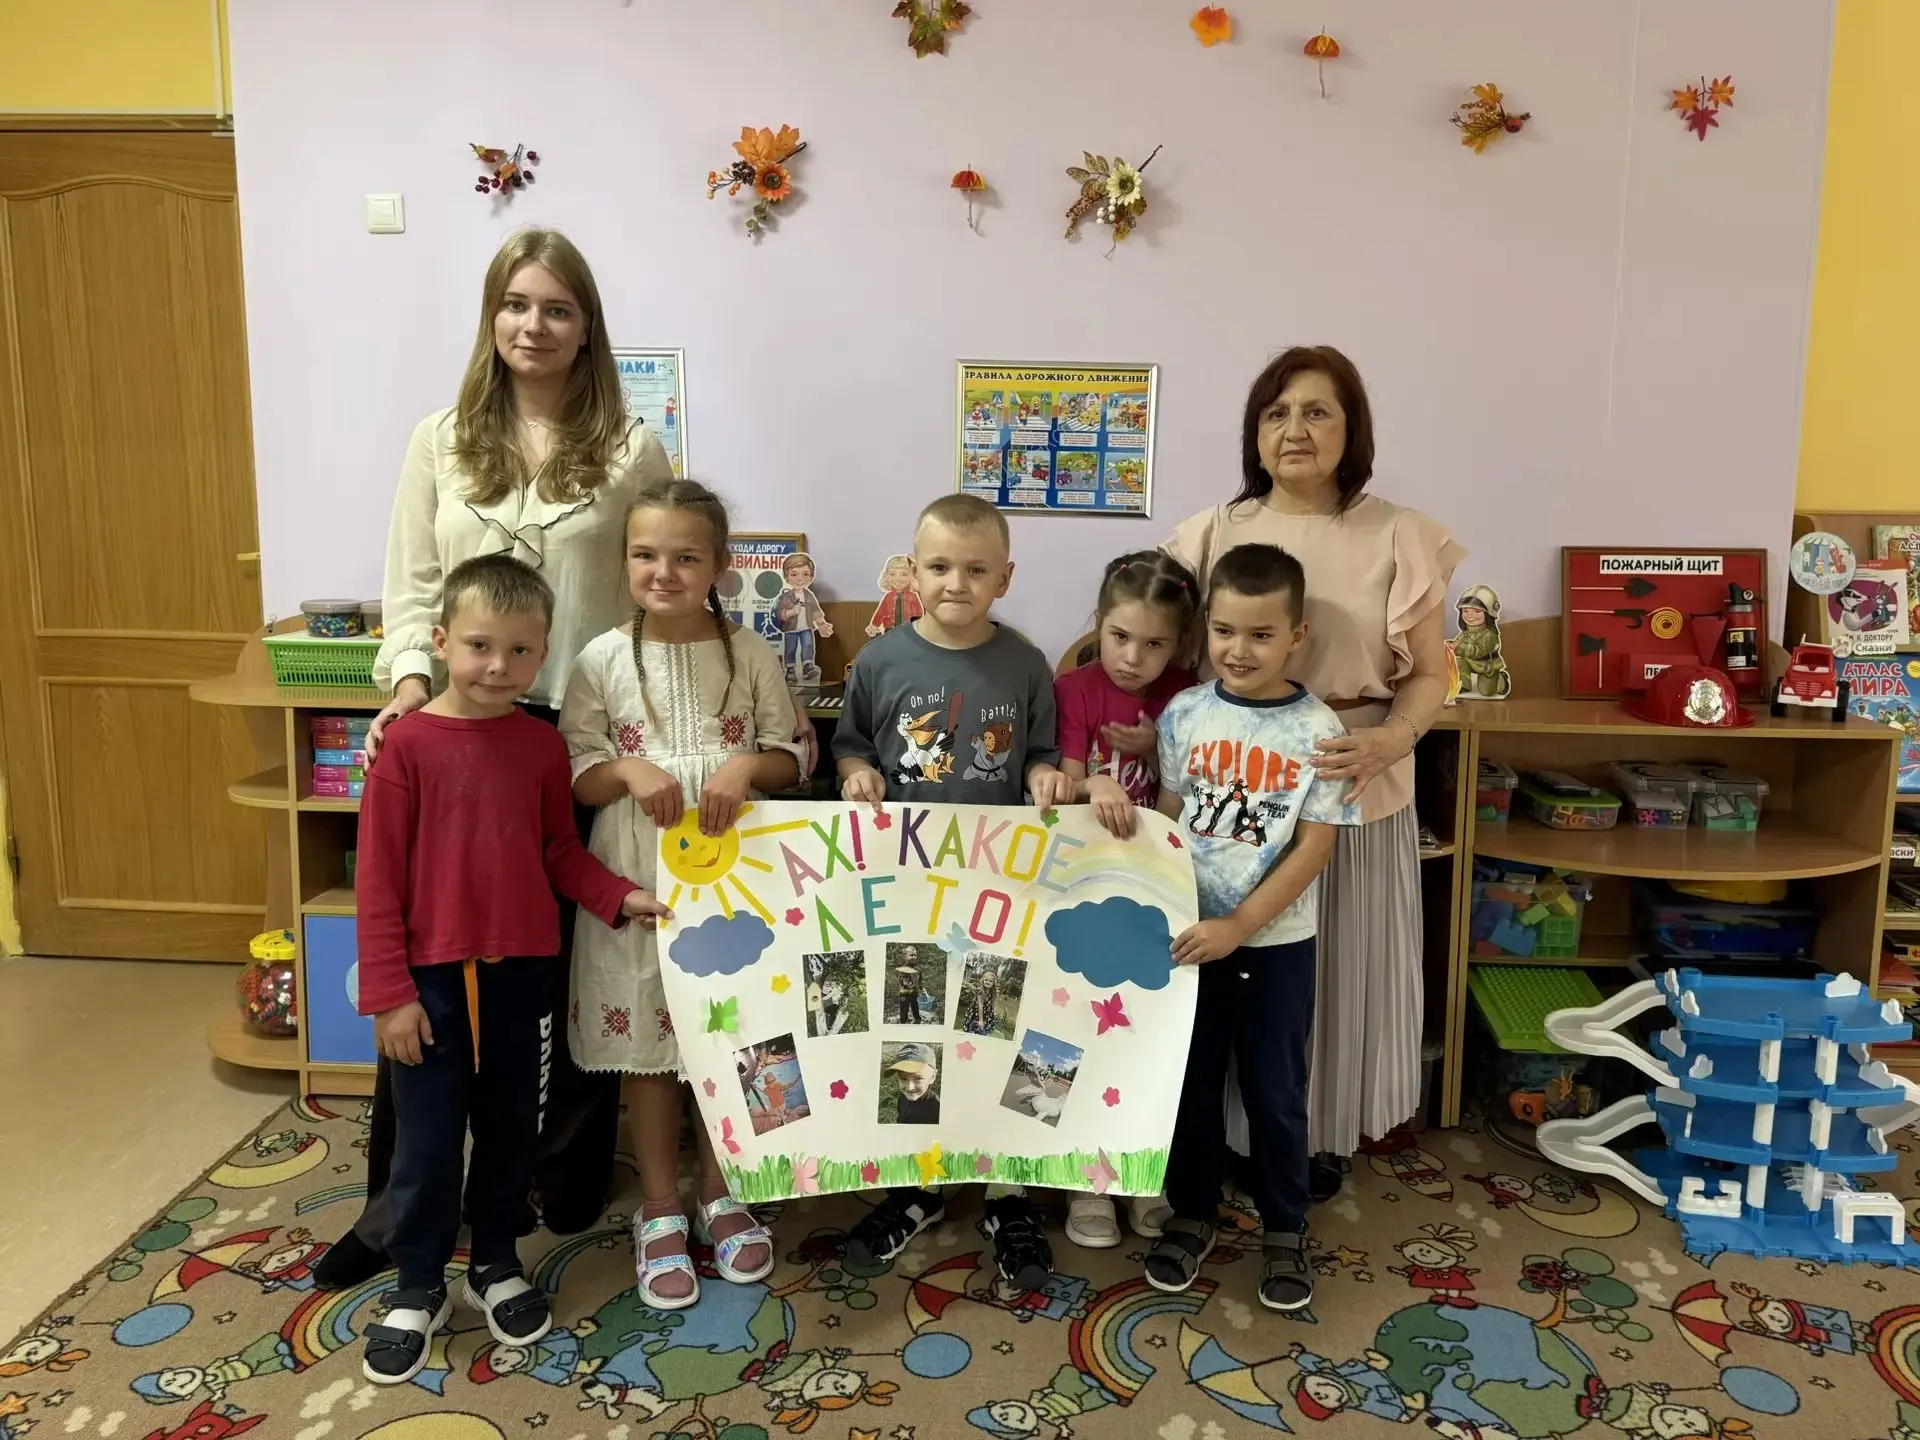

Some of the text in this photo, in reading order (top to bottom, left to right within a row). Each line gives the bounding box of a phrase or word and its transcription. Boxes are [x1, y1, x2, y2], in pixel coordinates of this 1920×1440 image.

[1015, 372, 1085, 381] ДОРОЖНОГО
[1087, 374, 1149, 383] ДВИЖЕНИЯ
[755, 544, 786, 553] ДОРОГУ
[1601, 557, 1720, 573] ПОЖАРНЫЙ ЩИТ
[1864, 634, 1893, 642] ДОКТОРУ
[1855, 643, 1893, 652] Сказки
[1842, 662, 1904, 678] АТЛАС
[910, 686, 945, 708] Oh no!
[981, 702, 1017, 723] Battle!
[1187, 739, 1302, 793] EXPLORE
[778, 807, 1087, 898] АХ! КАКОЕ
[815, 874, 1037, 957] ЛЕТО!
